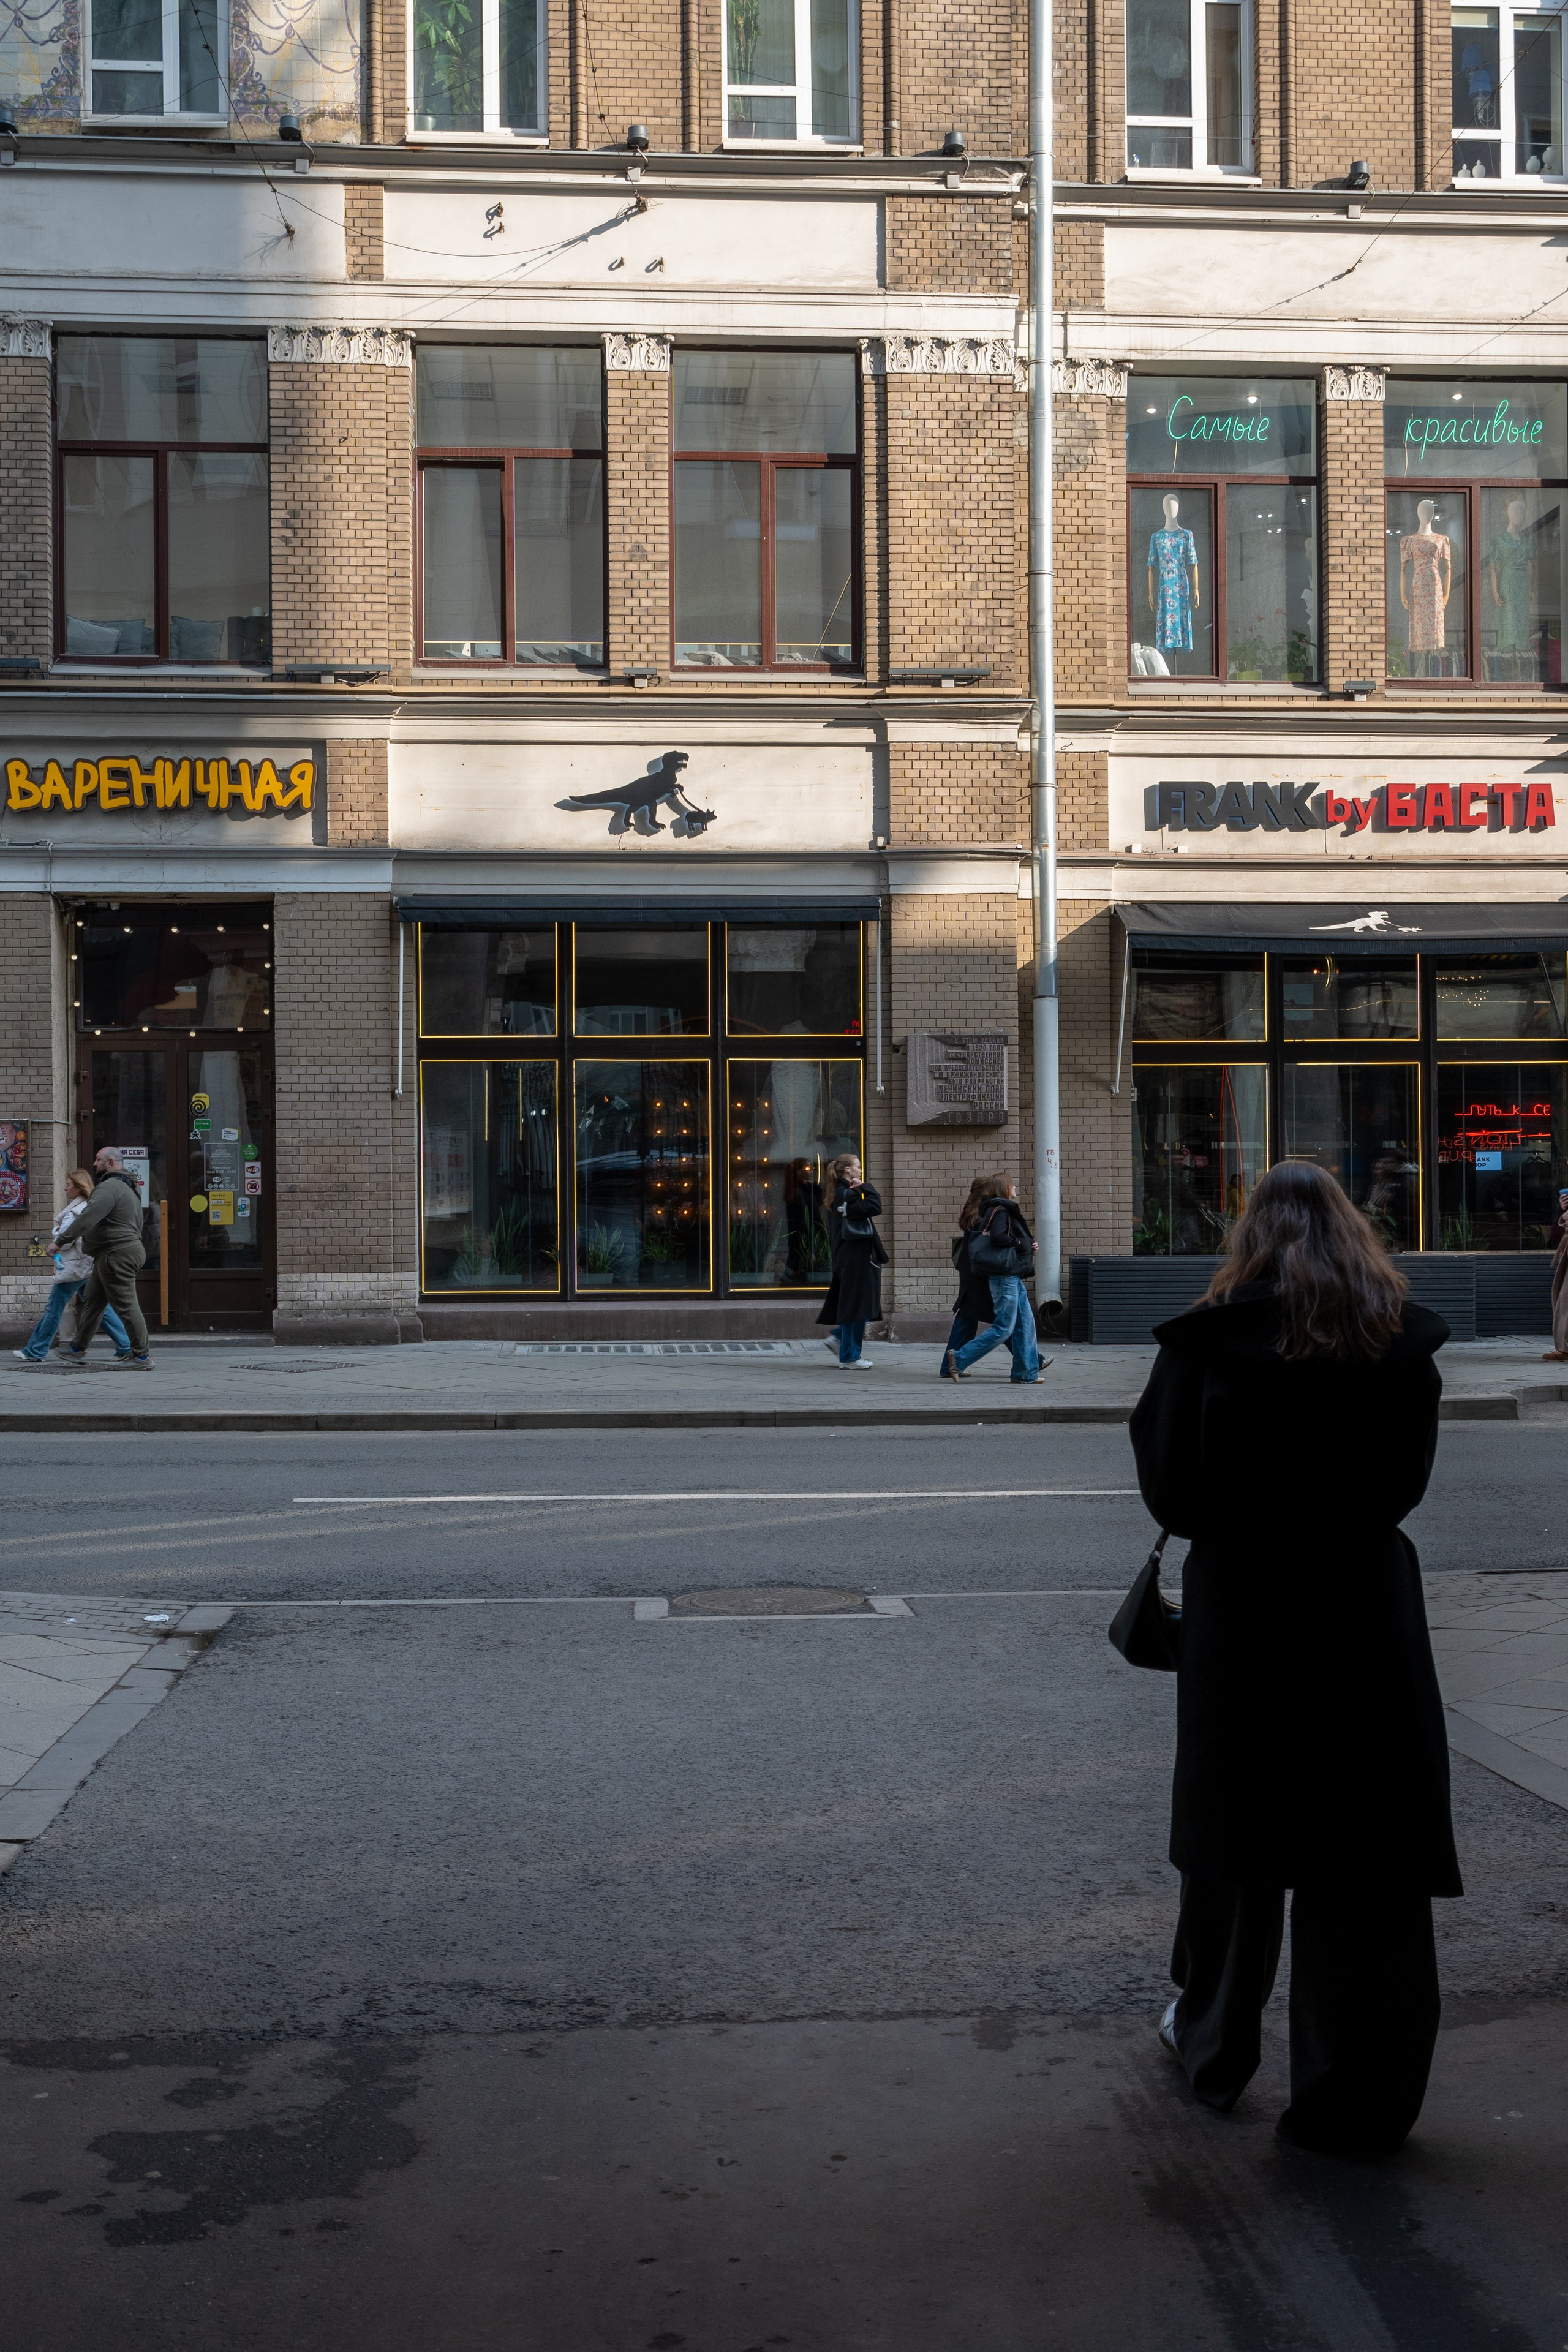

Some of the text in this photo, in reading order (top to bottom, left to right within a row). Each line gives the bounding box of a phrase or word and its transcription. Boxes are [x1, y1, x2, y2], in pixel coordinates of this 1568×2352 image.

[1167, 395, 1270, 442] Самые
[1404, 399, 1543, 461] красивые
[4, 754, 317, 813] ВАРЕНИЧНАЯ
[1158, 781, 1556, 831] FRANK by БАСТА
[948, 1112, 1005, 1123] ГОЭЛРО
